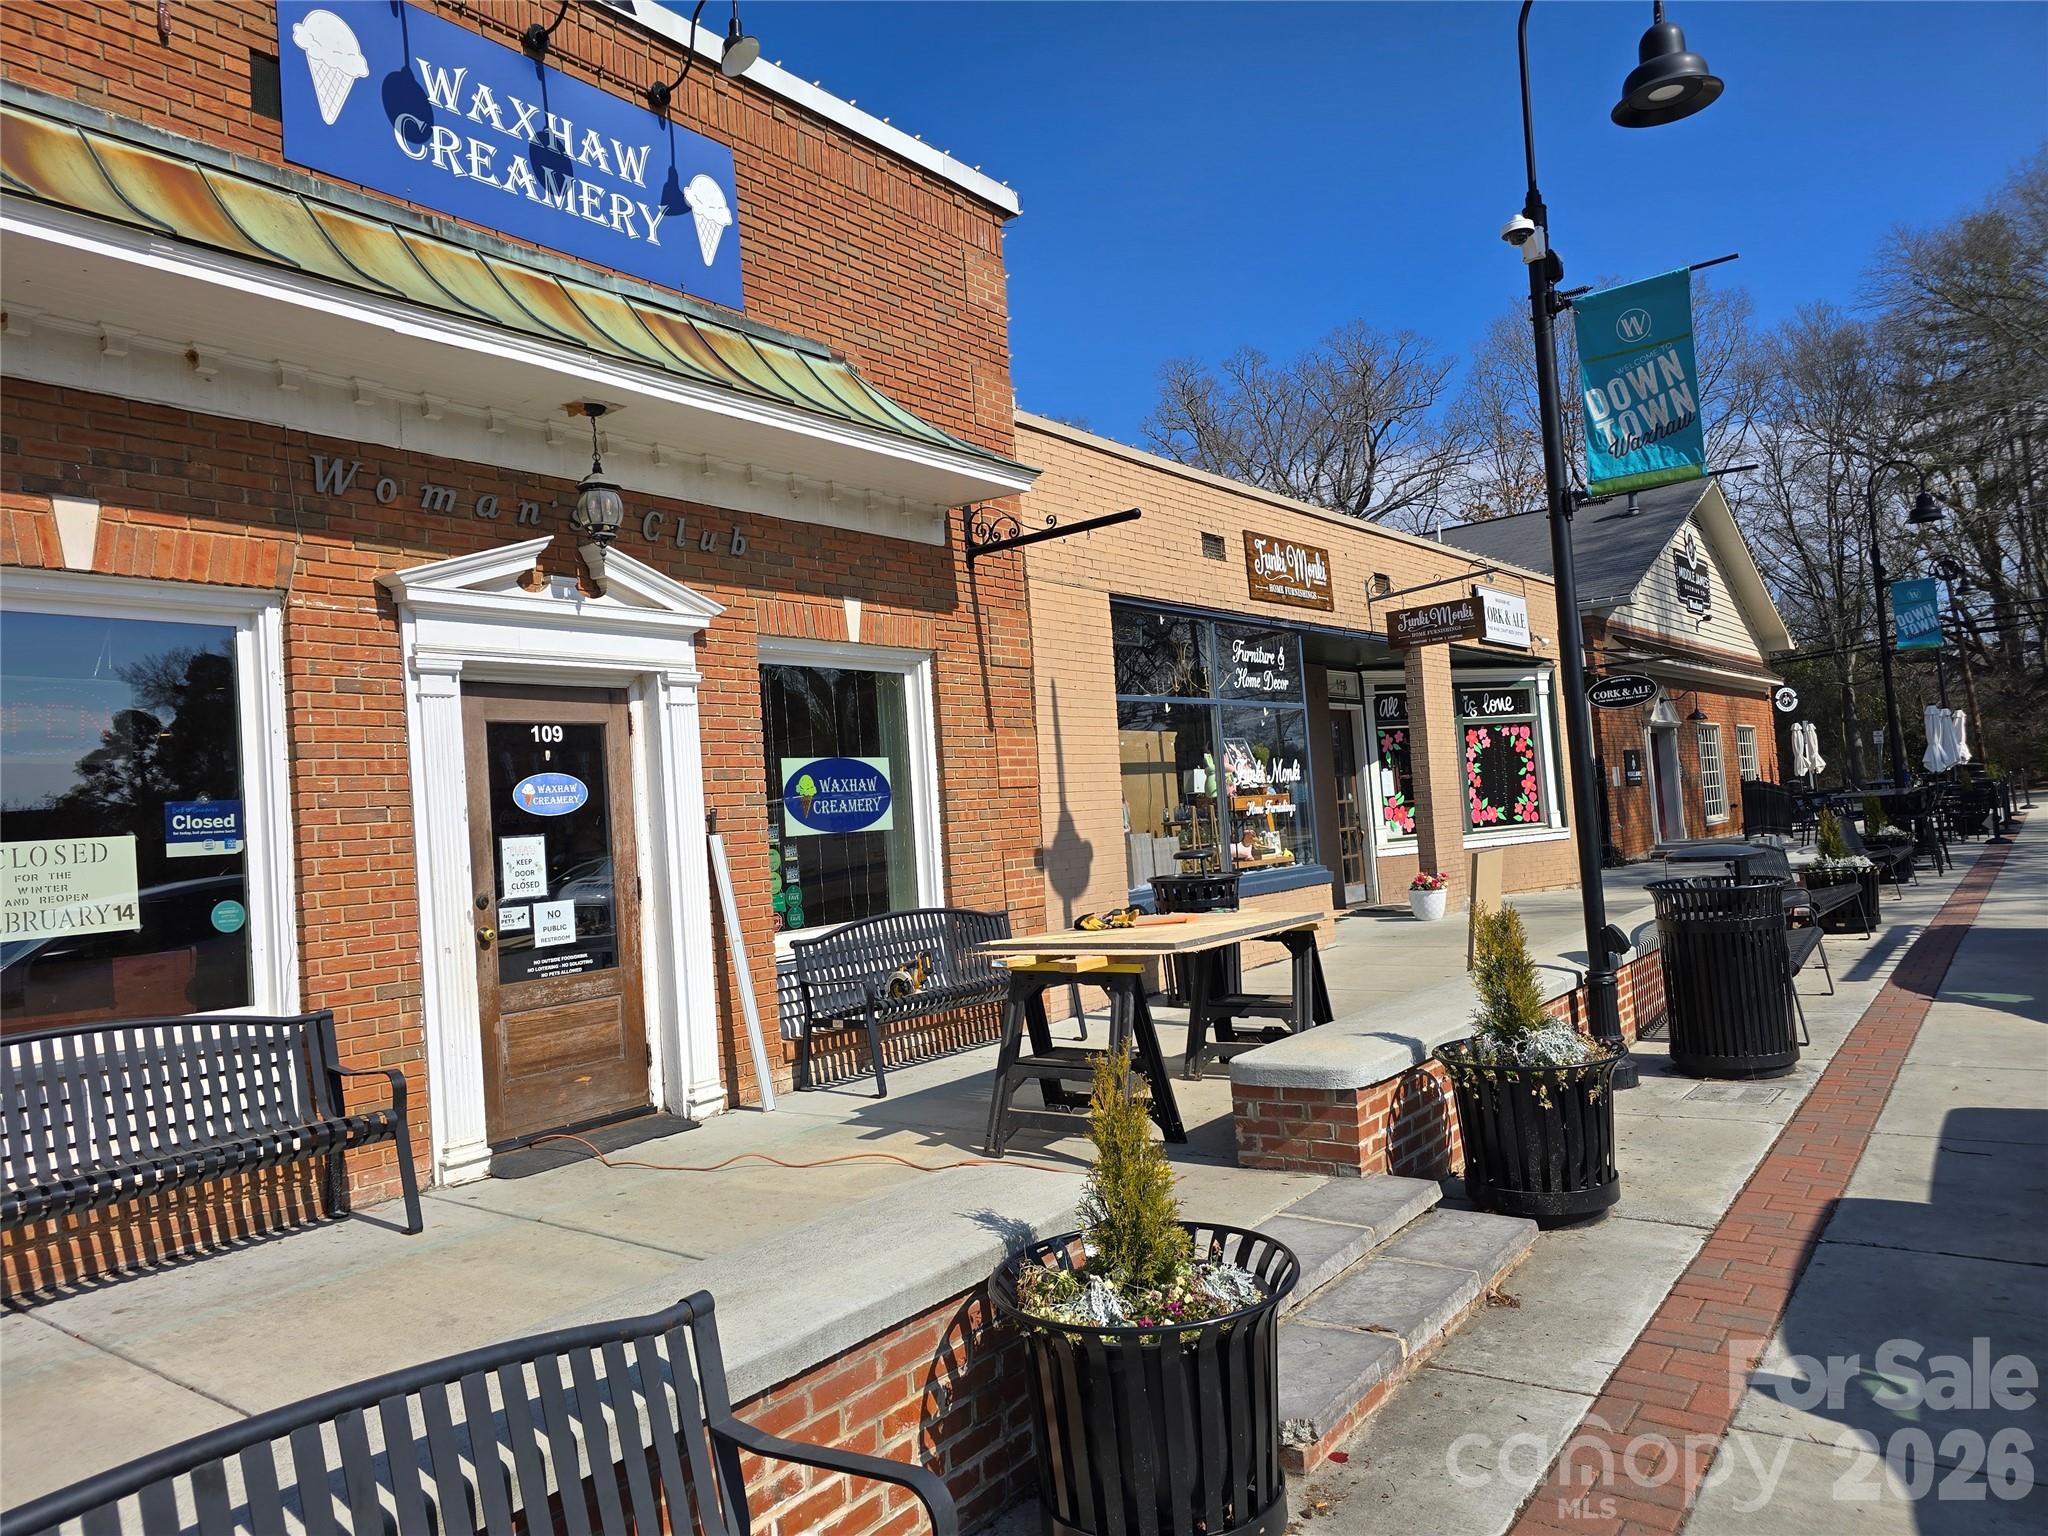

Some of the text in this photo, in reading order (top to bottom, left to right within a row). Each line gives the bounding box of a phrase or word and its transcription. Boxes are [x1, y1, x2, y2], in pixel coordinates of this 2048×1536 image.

[416, 57, 652, 189] WAXHAW
[394, 112, 669, 246] CREAMERY
[1615, 347, 1659, 376] WELCOME
[1585, 349, 1685, 422] DOWN
[1595, 381, 1697, 448] TOWN
[1608, 410, 1696, 460] Waxhaw
[642, 510, 747, 556] Club
[1254, 538, 1328, 588] Funki Monki
[1268, 583, 1285, 594] HOME
[1397, 602, 1474, 632] Funki Monki
[1486, 606, 1526, 629] ORK & ALE
[1896, 604, 1934, 626] DOWN
[1411, 630, 1426, 638] HOME
[1900, 616, 1939, 635] TOWN
[1232, 639, 1285, 671] Furniture &
[1234, 667, 1289, 691] Home Decor
[1592, 688, 1621, 700] CORK
[1622, 687, 1631, 696] &
[1632, 684, 1652, 695] ALE
[1379, 695, 1400, 718] all
[1463, 692, 1515, 717] is love
[530, 725, 564, 743] 109
[1267, 757, 1301, 784] Monki
[537, 783, 578, 794] WAXHAW
[819, 775, 878, 793] WAXHAW
[533, 794, 580, 806] CREAMERY
[813, 796, 882, 814] CREAMERY
[1246, 800, 1265, 816] Home
[172, 813, 235, 830] Closed
[516, 858, 533, 866] KEEP
[14, 871, 72, 883] FOR THE
[514, 869, 535, 877] DOOR
[17, 884, 69, 895] WINTER
[511, 880, 540, 890] CLOSED
[4, 893, 89, 907] AND REOPEN
[0, 903, 135, 934] BRUARY 14
[547, 909, 562, 919] NO
[542, 924, 568, 932] PUBLIC
[540, 935, 571, 943] RESTROOM
